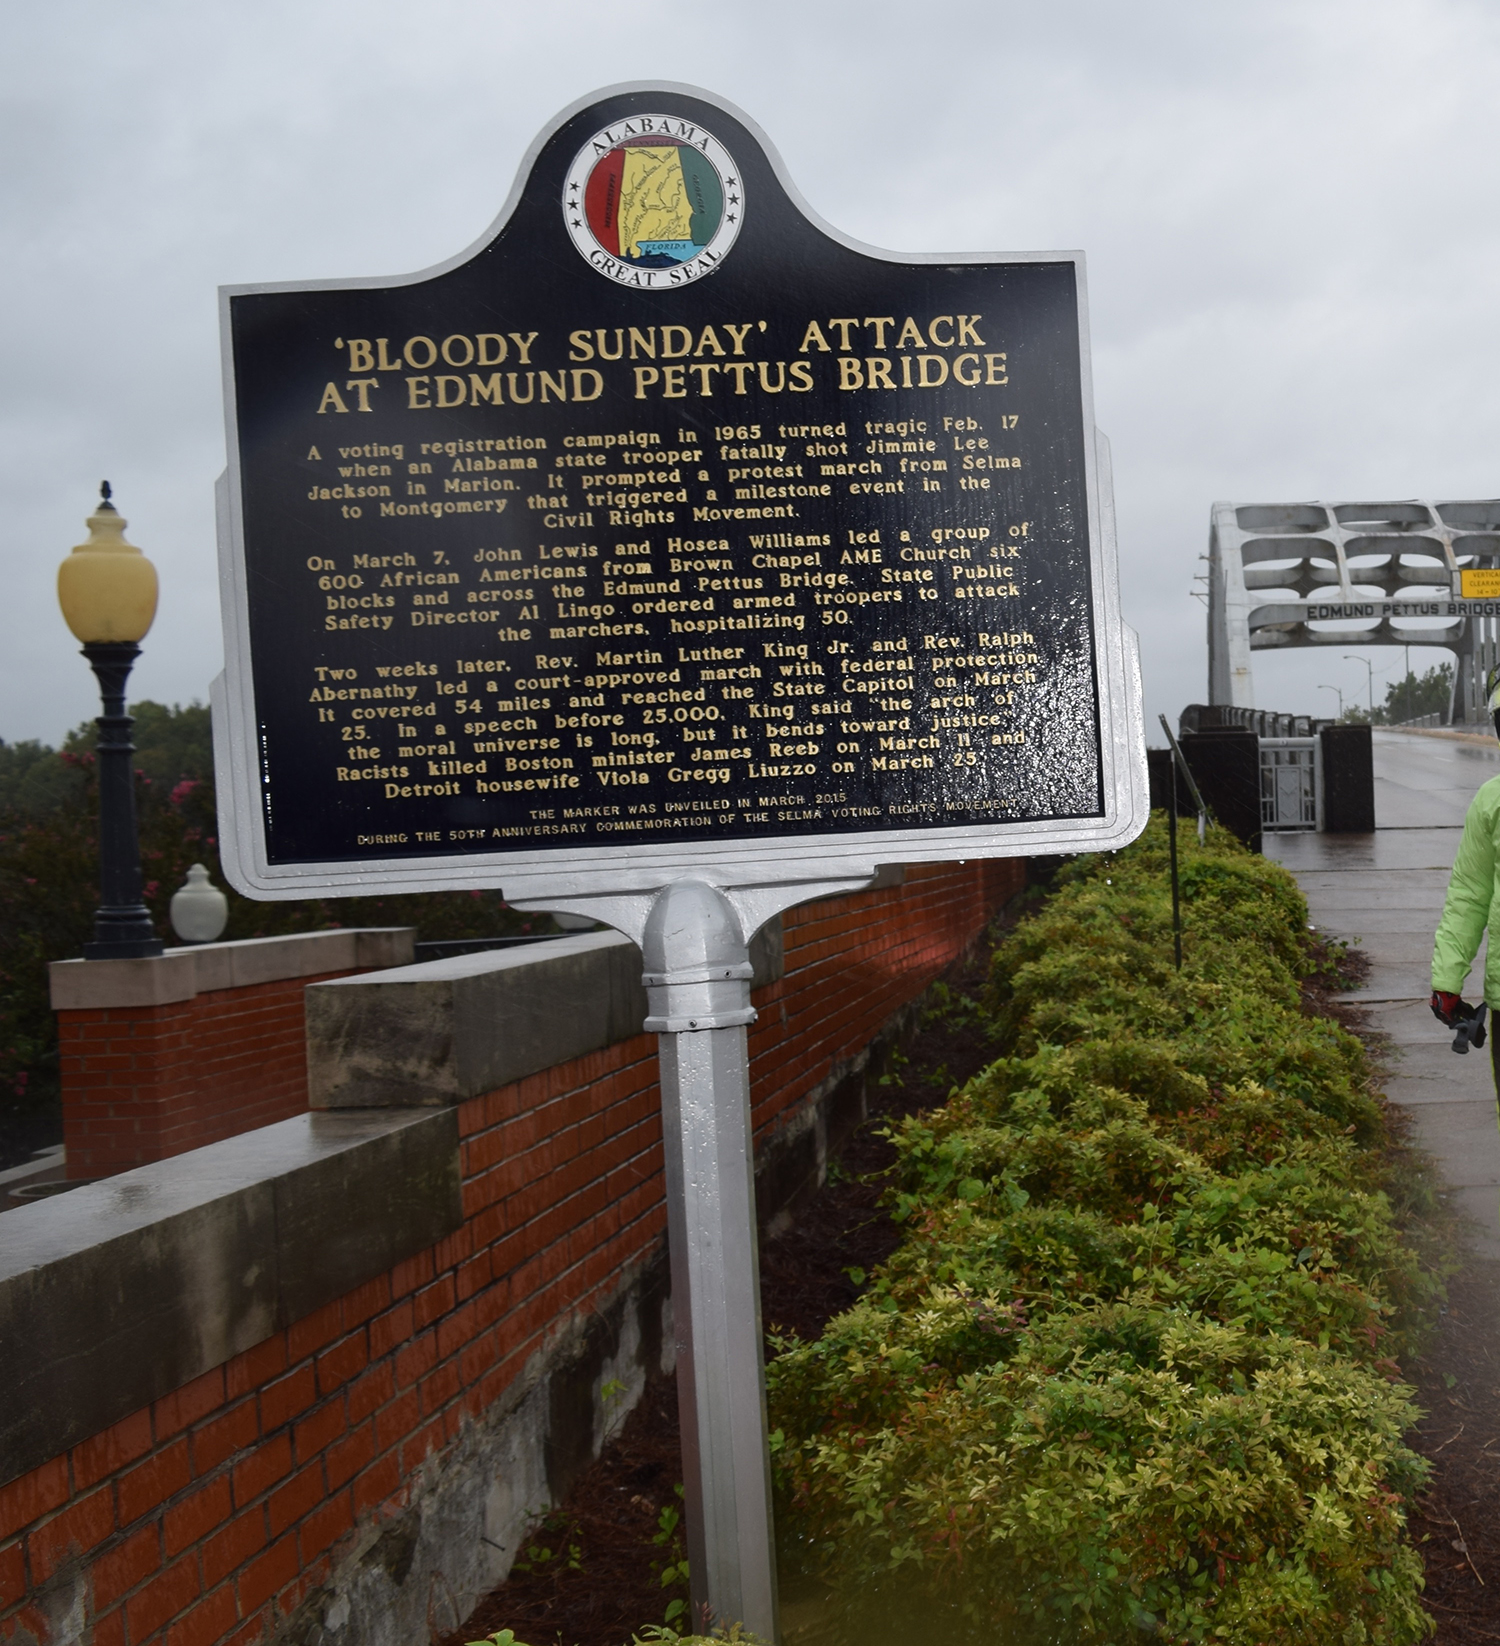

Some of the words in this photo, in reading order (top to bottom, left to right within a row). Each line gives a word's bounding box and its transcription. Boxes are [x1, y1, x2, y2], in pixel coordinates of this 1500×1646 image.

[592, 118, 710, 156] ALABAMA
[693, 174, 705, 215] GEORGIA
[590, 249, 657, 286] GREAT
[670, 249, 722, 285] SEAL
[799, 314, 985, 352] ATTACK
[318, 378, 379, 414] AT
[406, 369, 604, 409] EDMUND
[633, 361, 814, 399] PETTUS
[837, 353, 1008, 390] BRIDGE
[309, 447, 321, 460] A
[339, 443, 403, 460] voting
[422, 436, 546, 457] registration
[563, 430, 660, 448] campaign
[678, 429, 697, 442] in
[715, 424, 761, 441] 1965
[779, 422, 846, 438] turned
[865, 420, 925, 437] tragic
[943, 417, 983, 431] Feb.
[1002, 415, 1018, 428] 17
[339, 464, 391, 477] when
[409, 463, 432, 475] an
[453, 457, 538, 472] Alabama
[555, 453, 606, 468] state
[622, 450, 702, 465] trooper
[720, 444, 786, 460] fatally
[806, 442, 847, 456] shot
[866, 439, 935, 453] Jimmie
[954, 437, 987, 450] Lee
[309, 484, 391, 500] Jackson
[408, 482, 426, 495] in
[445, 477, 518, 493] Marion.
[548, 474, 562, 488] It
[582, 468, 681, 489] prompted
[698, 470, 709, 481] a
[728, 465, 802, 482] protest
[820, 460, 882, 475] march
[899, 458, 947, 472] from
[962, 455, 1021, 470] Selma
[342, 506, 362, 518] to
[381, 499, 507, 518] Montgomery
[527, 495, 567, 509] that
[586, 488, 687, 509] triggered
[706, 489, 717, 501] a
[735, 484, 830, 499] milestone
[849, 480, 903, 494] event
[923, 478, 940, 491] in
[959, 477, 989, 489] the
[543, 512, 593, 528] Civil
[609, 509, 675, 527] Rights
[693, 504, 800, 521] Movement.
[319, 574, 362, 590] 600
[381, 572, 459, 587] African
[480, 565, 586, 581] Americans
[603, 561, 652, 576] from
[670, 558, 733, 572] Brown
[752, 552, 820, 569] Chapel
[840, 548, 881, 564] AME
[900, 546, 971, 561] Church
[990, 545, 1018, 557] six
[327, 593, 395, 610] blocks
[413, 591, 448, 606] and
[467, 589, 533, 603] across
[552, 584, 584, 598] the
[604, 579, 680, 596] Edmund
[698, 577, 763, 591] Pettus
[780, 572, 855, 589] Bridge.
[881, 568, 932, 583] State
[952, 565, 1012, 580] Public
[325, 614, 393, 630] Safety
[411, 610, 499, 626] Director
[519, 605, 539, 620] Al
[558, 603, 614, 620] Lingo
[632, 597, 714, 614] ordered
[733, 592, 795, 609] armed
[814, 590, 902, 605] troopers
[918, 588, 937, 600] to
[954, 582, 1018, 599] attack
[1306, 605, 1375, 619] EDMUND
[1382, 603, 1440, 616] PETTUS
[315, 667, 357, 681] Two
[376, 662, 437, 677] weeks
[535, 655, 576, 669] Rev.
[596, 650, 662, 666] Martin
[678, 647, 743, 662] Luther
[764, 643, 808, 660] King
[827, 640, 852, 654] Jr.
[872, 637, 907, 652] and
[924, 635, 965, 649] Rev.
[978, 631, 1034, 647] Ralph
[319, 708, 335, 722] It
[352, 702, 436, 720] covered
[455, 699, 481, 714] 54
[498, 696, 550, 712] miles
[569, 693, 604, 707] and
[622, 687, 705, 705] reached
[721, 686, 753, 699] the
[773, 682, 824, 697] State
[842, 675, 913, 695] Capitol
[934, 677, 957, 688] on
[974, 669, 1035, 686] March
[337, 765, 409, 781] Racists
[428, 760, 487, 776] killed
[506, 757, 573, 771] Boston
[592, 751, 675, 767] minister
[691, 747, 751, 761] James
[769, 741, 819, 757] Reeb
[837, 742, 860, 753] on
[879, 735, 940, 751] March
[957, 733, 970, 747] 11
[991, 730, 1025, 745] and
[358, 834, 406, 844] DURING
[416, 832, 439, 841] THE
[451, 830, 483, 839] 50TH
[493, 825, 585, 836] ANNIVERSARY
[597, 818, 710, 831] COMMEMORATION
[718, 813, 735, 824] OF
[744, 812, 768, 822] THE
[778, 811, 819, 821] SELMA
[833, 807, 878, 816] VOTING
[890, 803, 935, 813] RIGHTS
[946, 798, 1015, 810] MOVEMENT
[530, 810, 553, 818] THE
[563, 806, 619, 817] MARKER
[629, 805, 655, 813] WAS
[665, 800, 729, 812] UNVEILED
[739, 798, 751, 808] IN
[759, 796, 803, 806] MARCH
[816, 793, 846, 803] 2015
